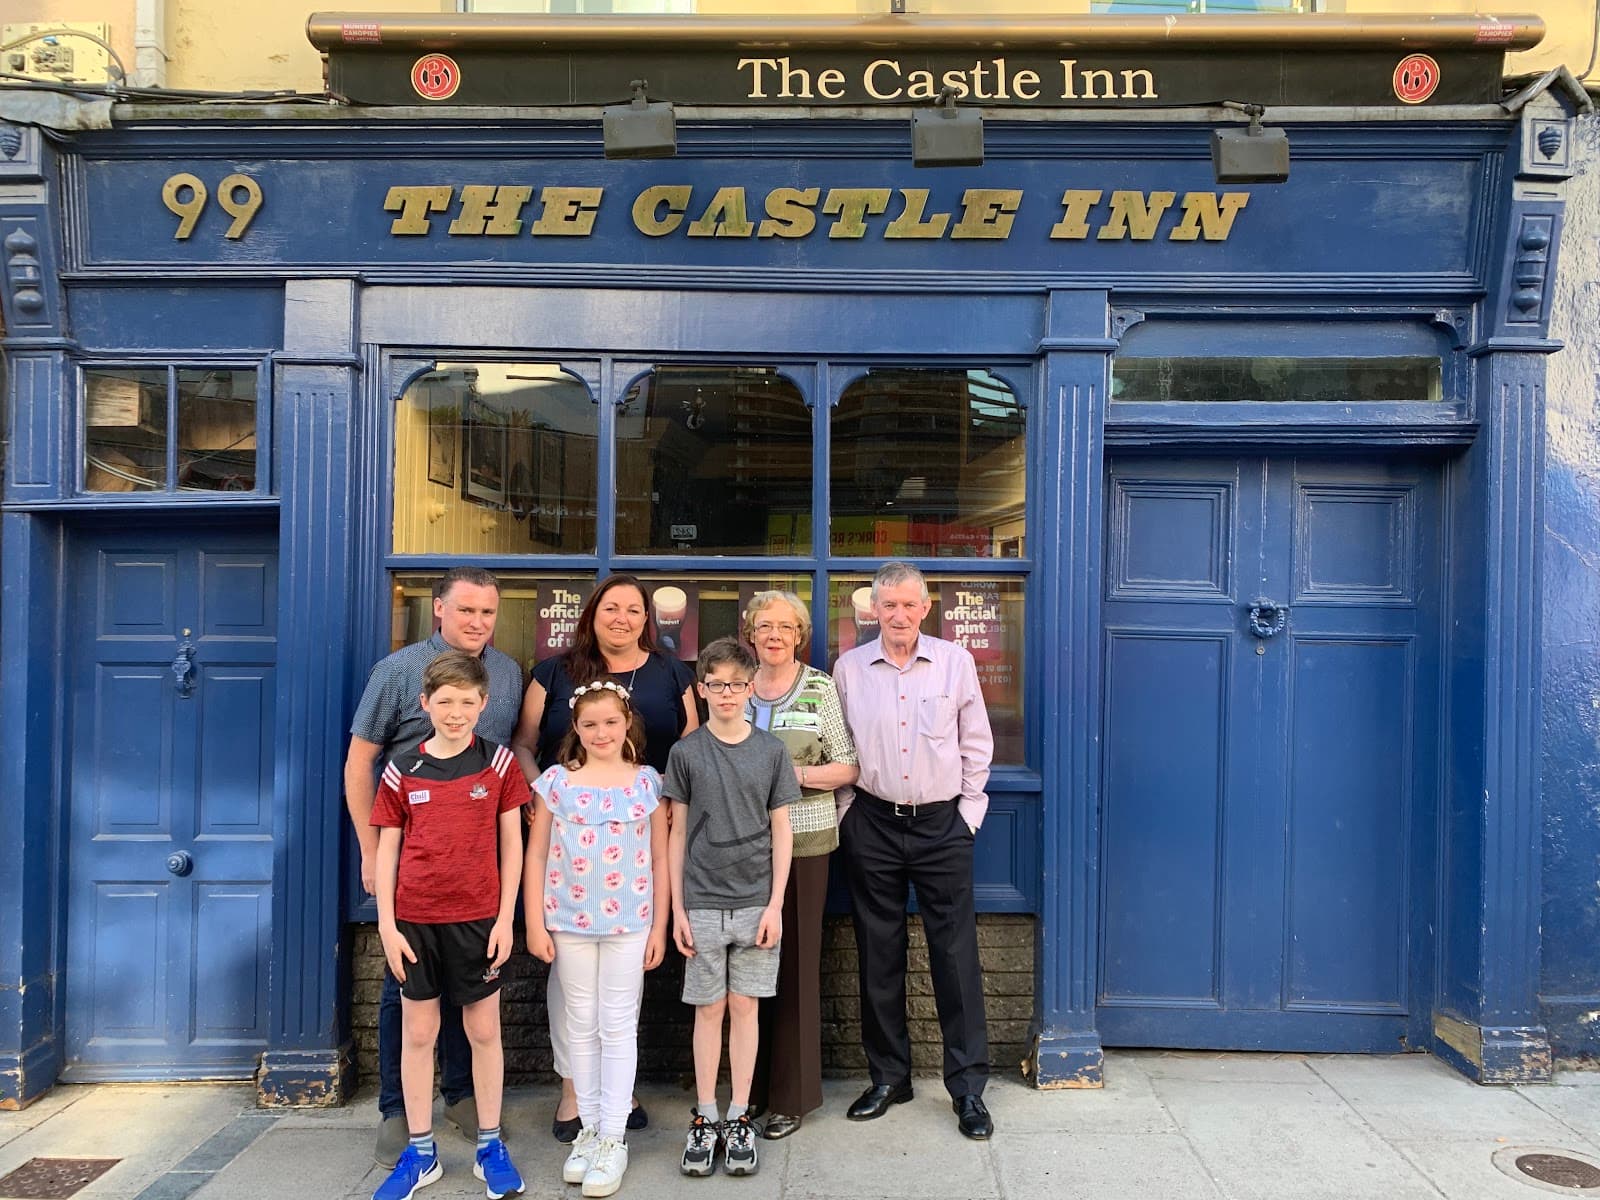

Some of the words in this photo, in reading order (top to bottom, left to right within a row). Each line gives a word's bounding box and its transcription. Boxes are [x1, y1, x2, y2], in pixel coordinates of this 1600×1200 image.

[737, 57, 846, 98] The
[863, 58, 1041, 100] Castle
[1059, 59, 1158, 99] Inn
[162, 172, 263, 240] 99
[383, 185, 605, 236] THE
[631, 185, 1023, 240] CASTLE
[1048, 189, 1251, 243] INN
[552, 589, 582, 604] The
[955, 591, 984, 605] The
[540, 604, 584, 619] offici
[944, 606, 997, 620] official
[955, 620, 986, 638] pint
[547, 633, 565, 648] of
[953, 635, 969, 649] of
[971, 639, 989, 649] us
